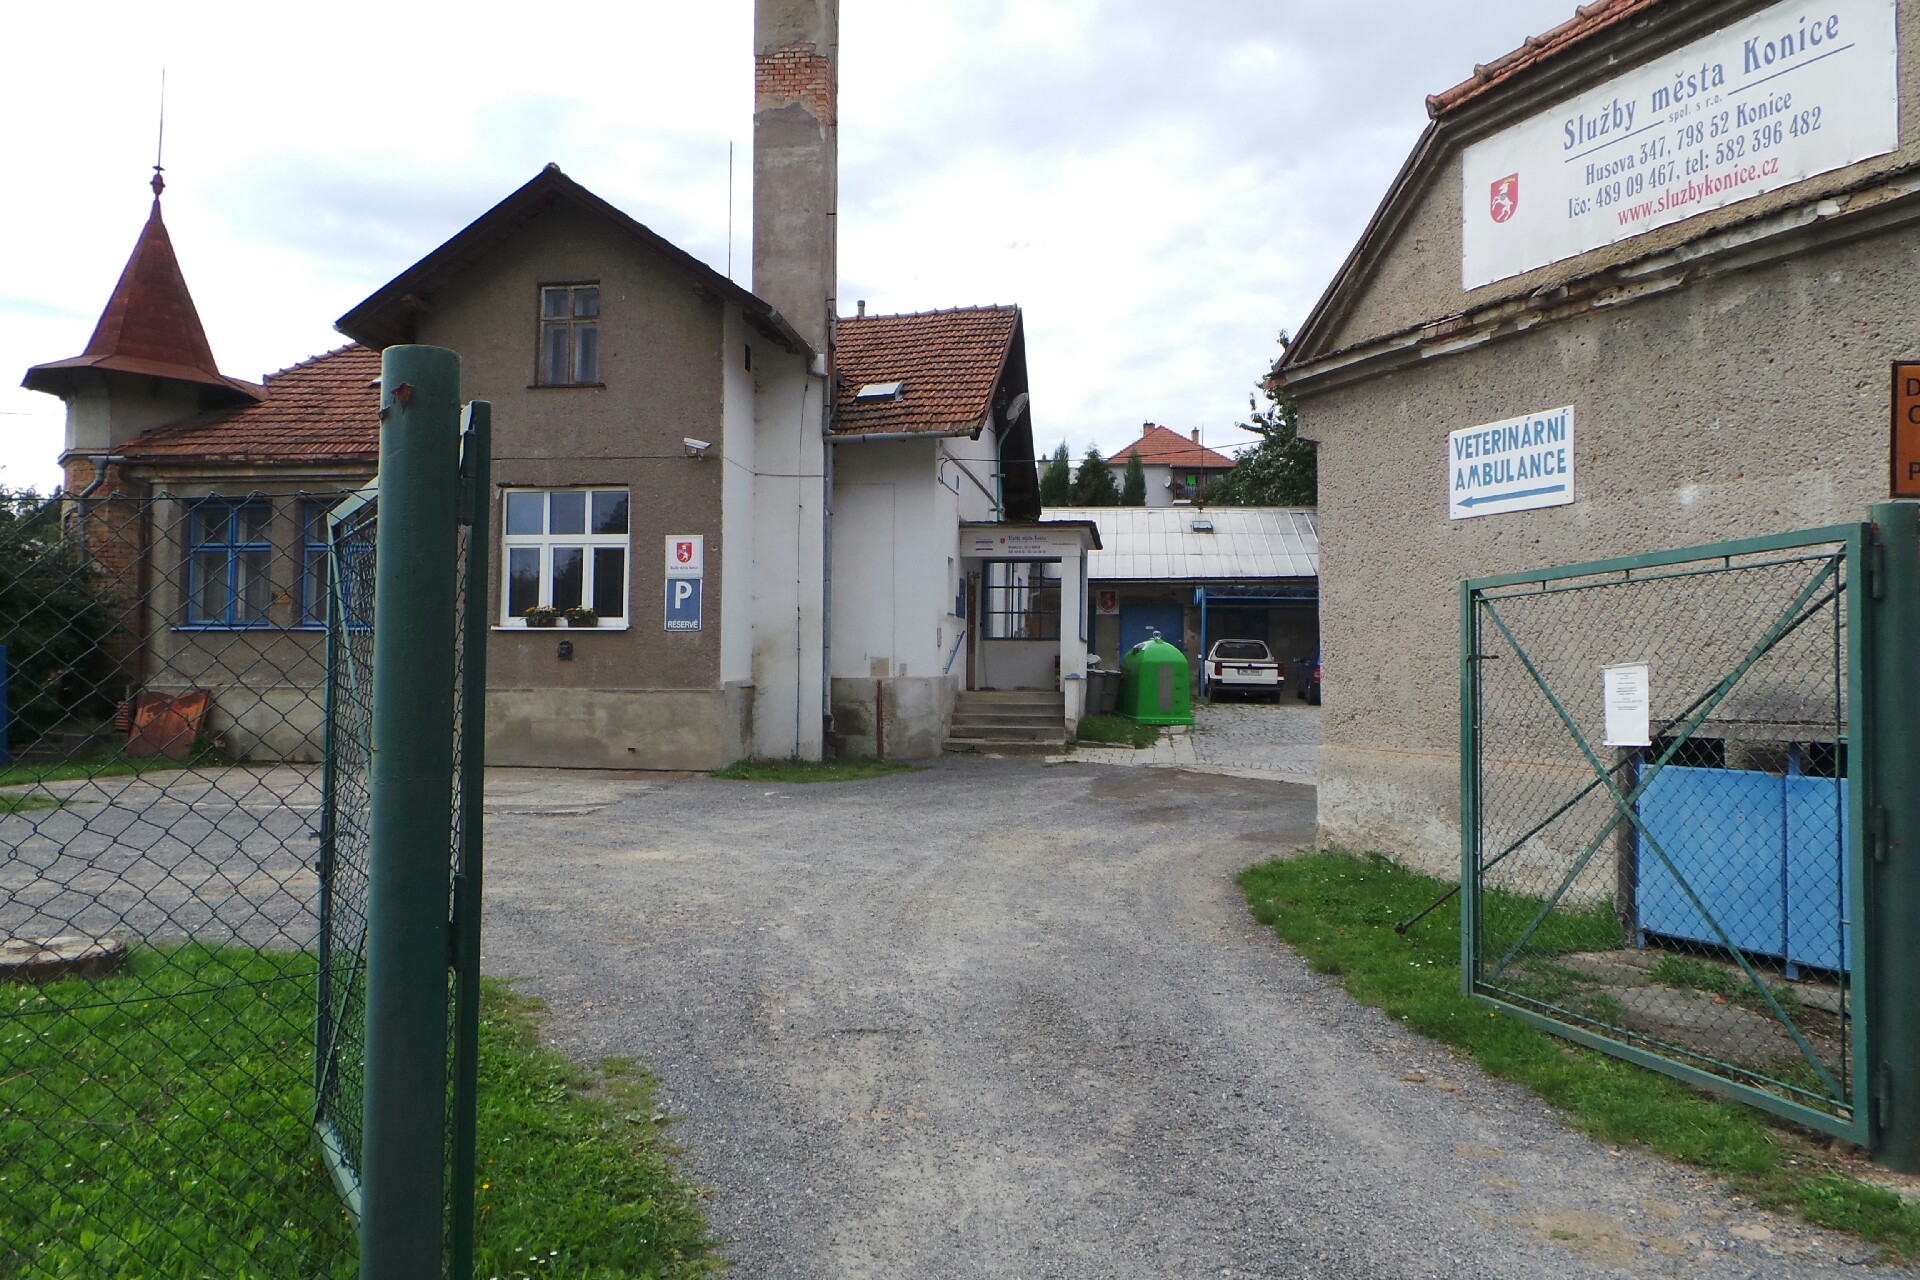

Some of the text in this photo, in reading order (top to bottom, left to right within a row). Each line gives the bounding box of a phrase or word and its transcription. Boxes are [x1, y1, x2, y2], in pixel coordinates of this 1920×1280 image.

[1563, 14, 1839, 151] Služby města Konice
[1668, 94, 1723, 123] spol. s r.o.
[1568, 106, 1822, 219] Ičo: 489 09 467, tel: 582 396 482
[1586, 92, 1792, 186] Husova 347, 798 52 Konice
[1618, 156, 1779, 226] www.sluzbykonice.cz
[1454, 408, 1567, 461] VETERINÁRNÍ
[1455, 448, 1567, 492] AMBULANCE
[674, 581, 692, 609] P
